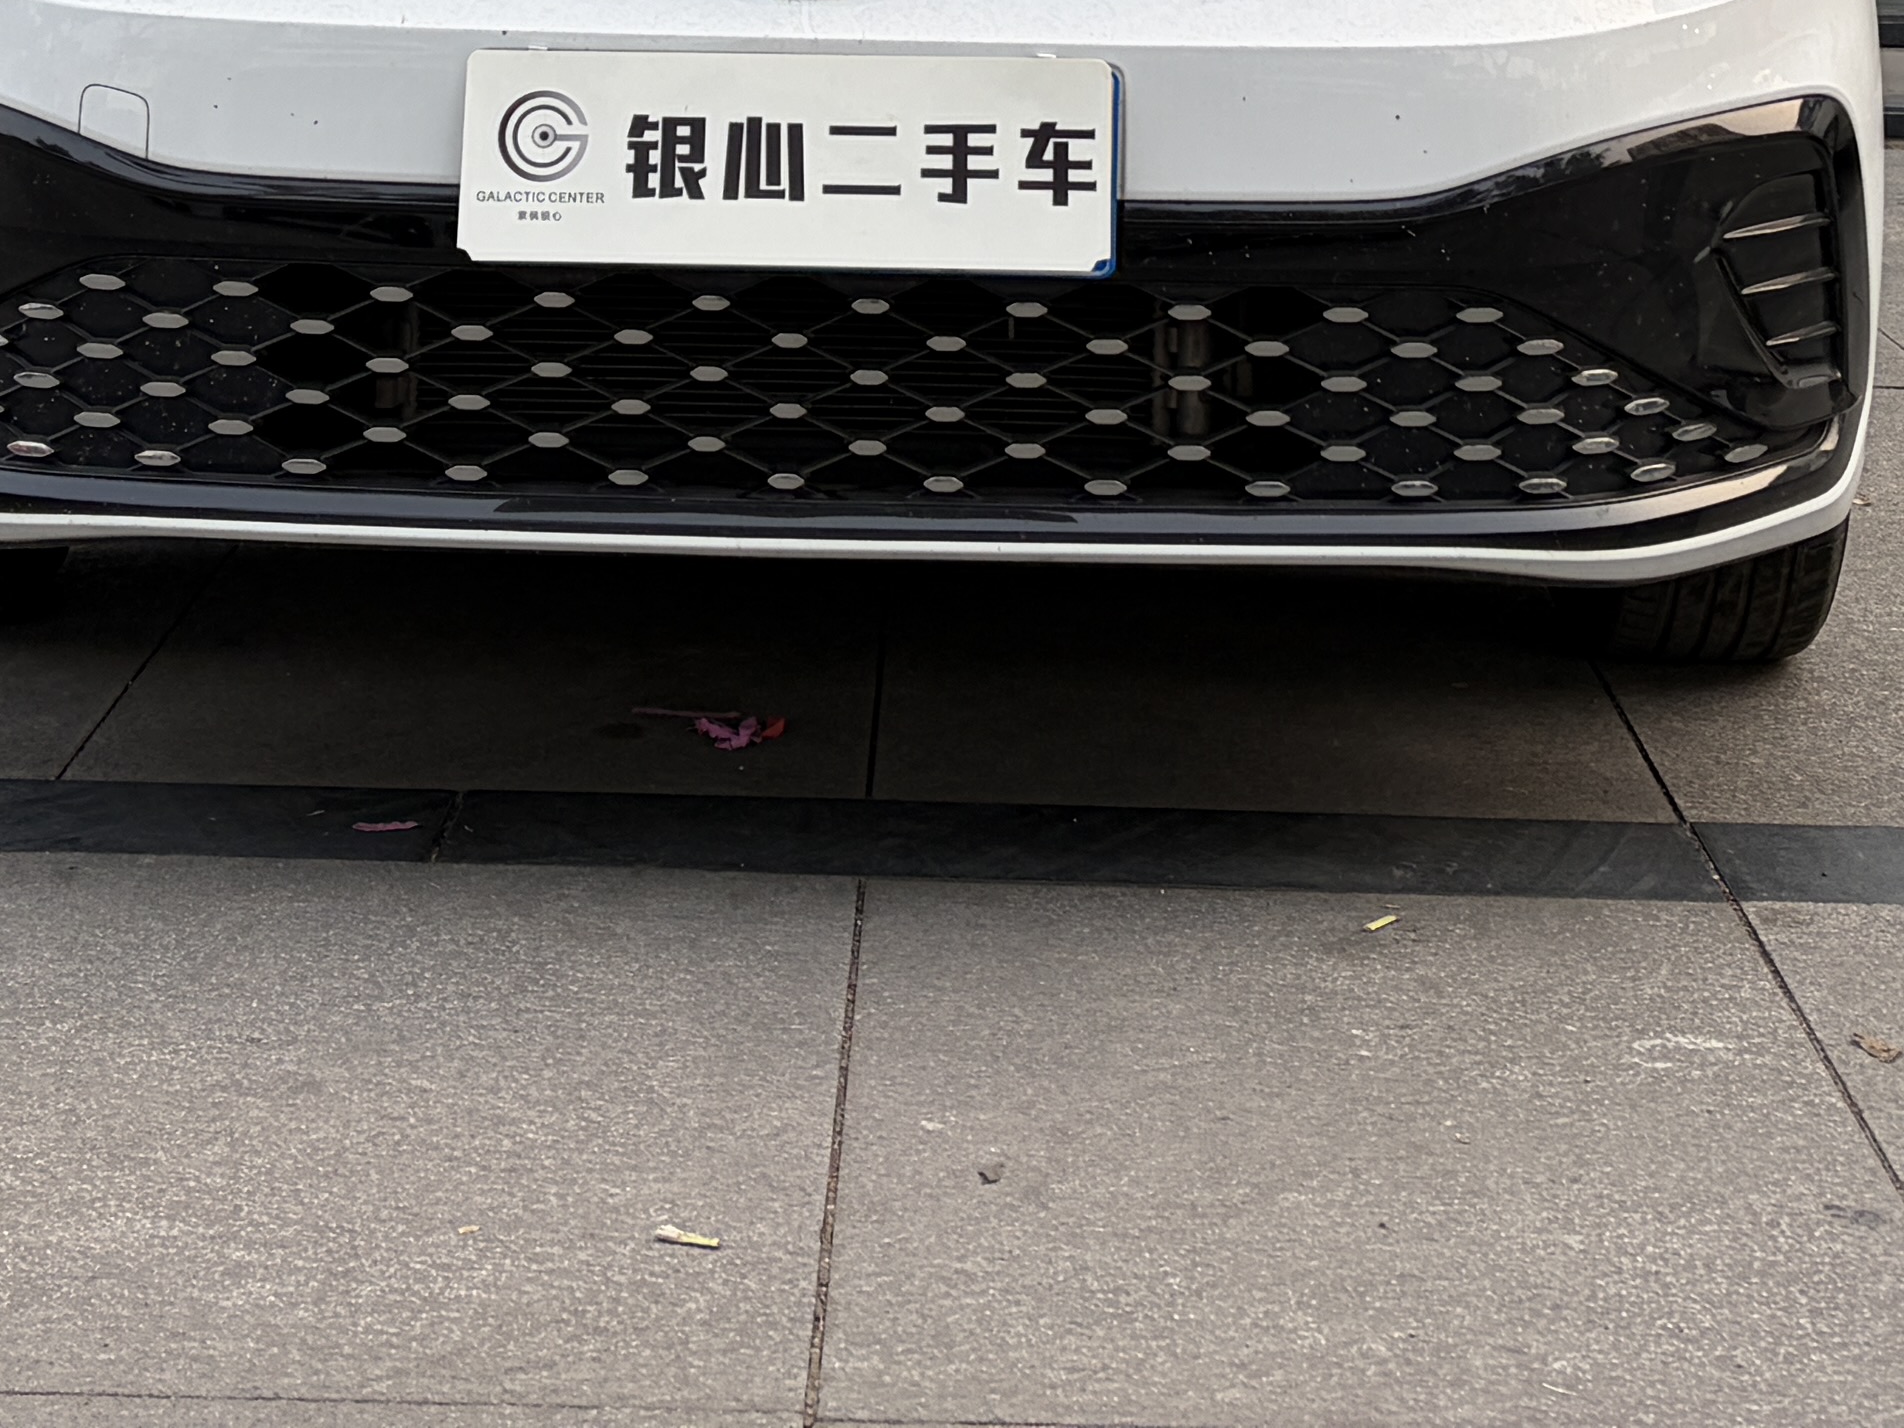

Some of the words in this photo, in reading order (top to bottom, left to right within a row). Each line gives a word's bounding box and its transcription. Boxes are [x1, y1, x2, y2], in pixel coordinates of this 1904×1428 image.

[625, 112, 1099, 208] 银心二手车
[475, 190, 546, 204] GALACTIC
[547, 191, 606, 205] CENTER
